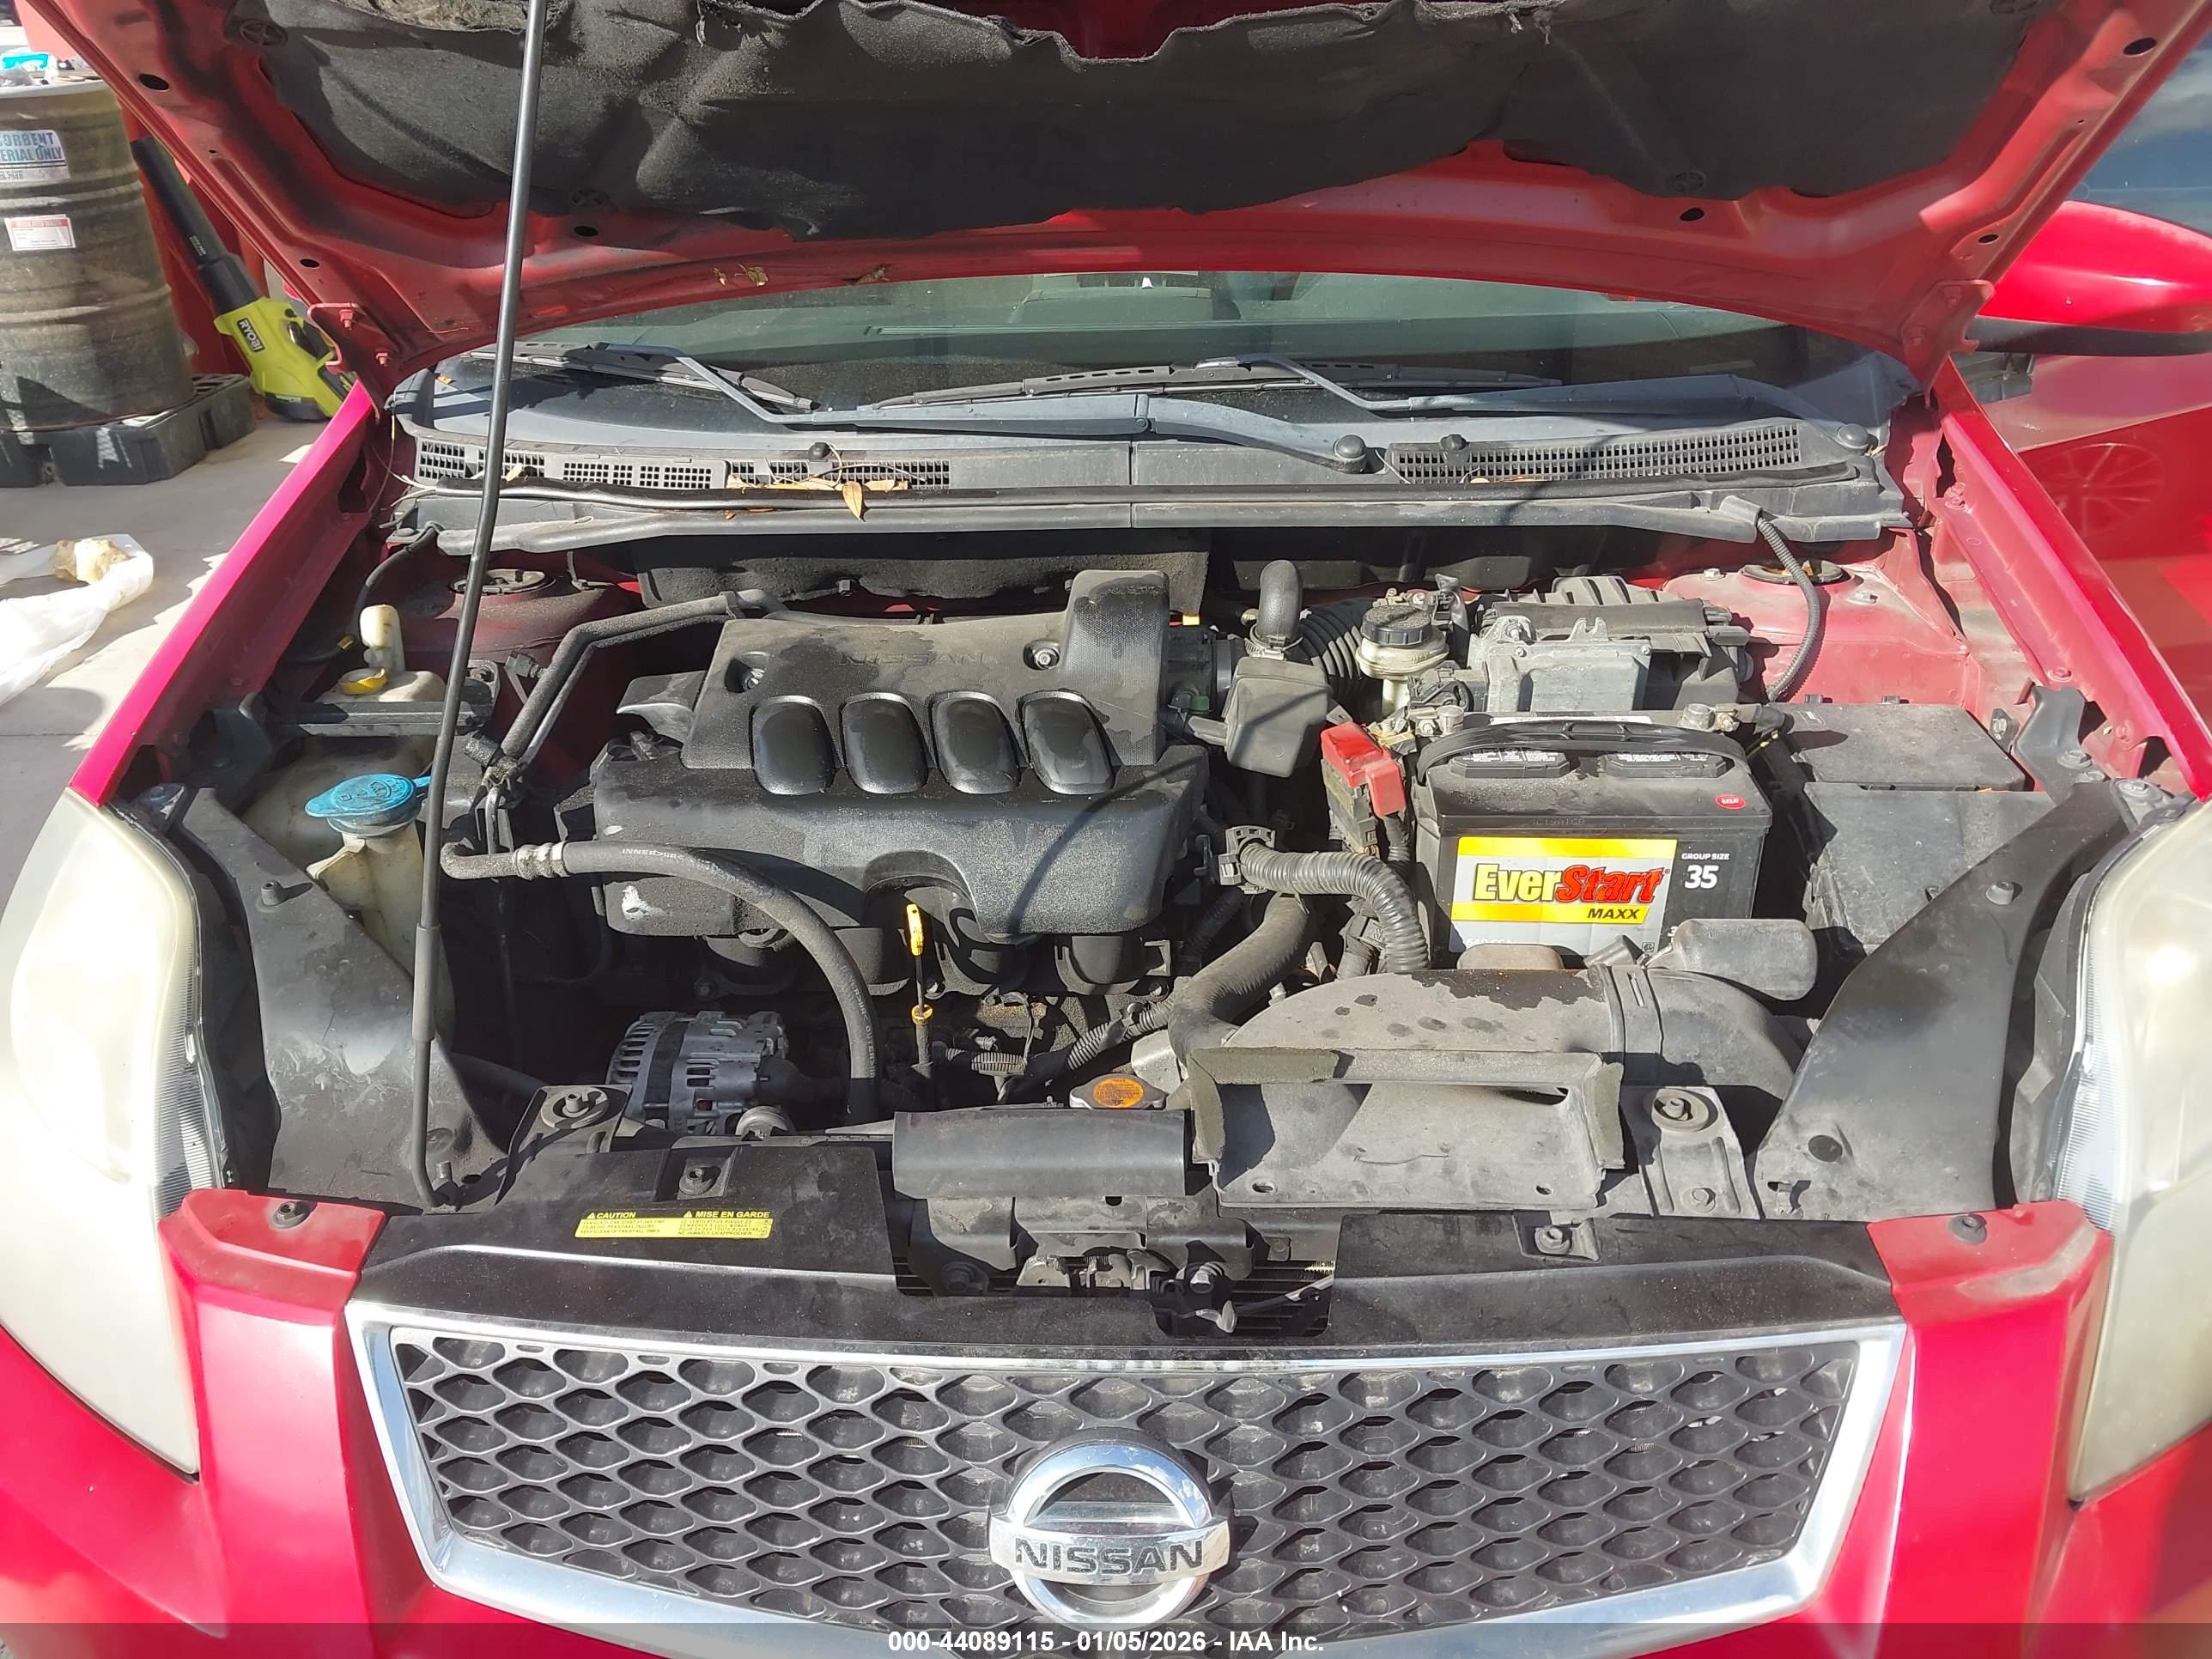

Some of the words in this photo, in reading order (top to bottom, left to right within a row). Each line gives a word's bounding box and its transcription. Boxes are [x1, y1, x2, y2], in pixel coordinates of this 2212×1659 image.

[35, 146, 63, 161] ONLY
[238, 319, 264, 352] RYOBI
[838, 653, 985, 666] NISSAN
[1473, 863, 1665, 903] EverStart
[1684, 864, 1719, 889] 35
[1587, 908, 1640, 920] MAXX
[1015, 1537, 1204, 1575] NISSAN
